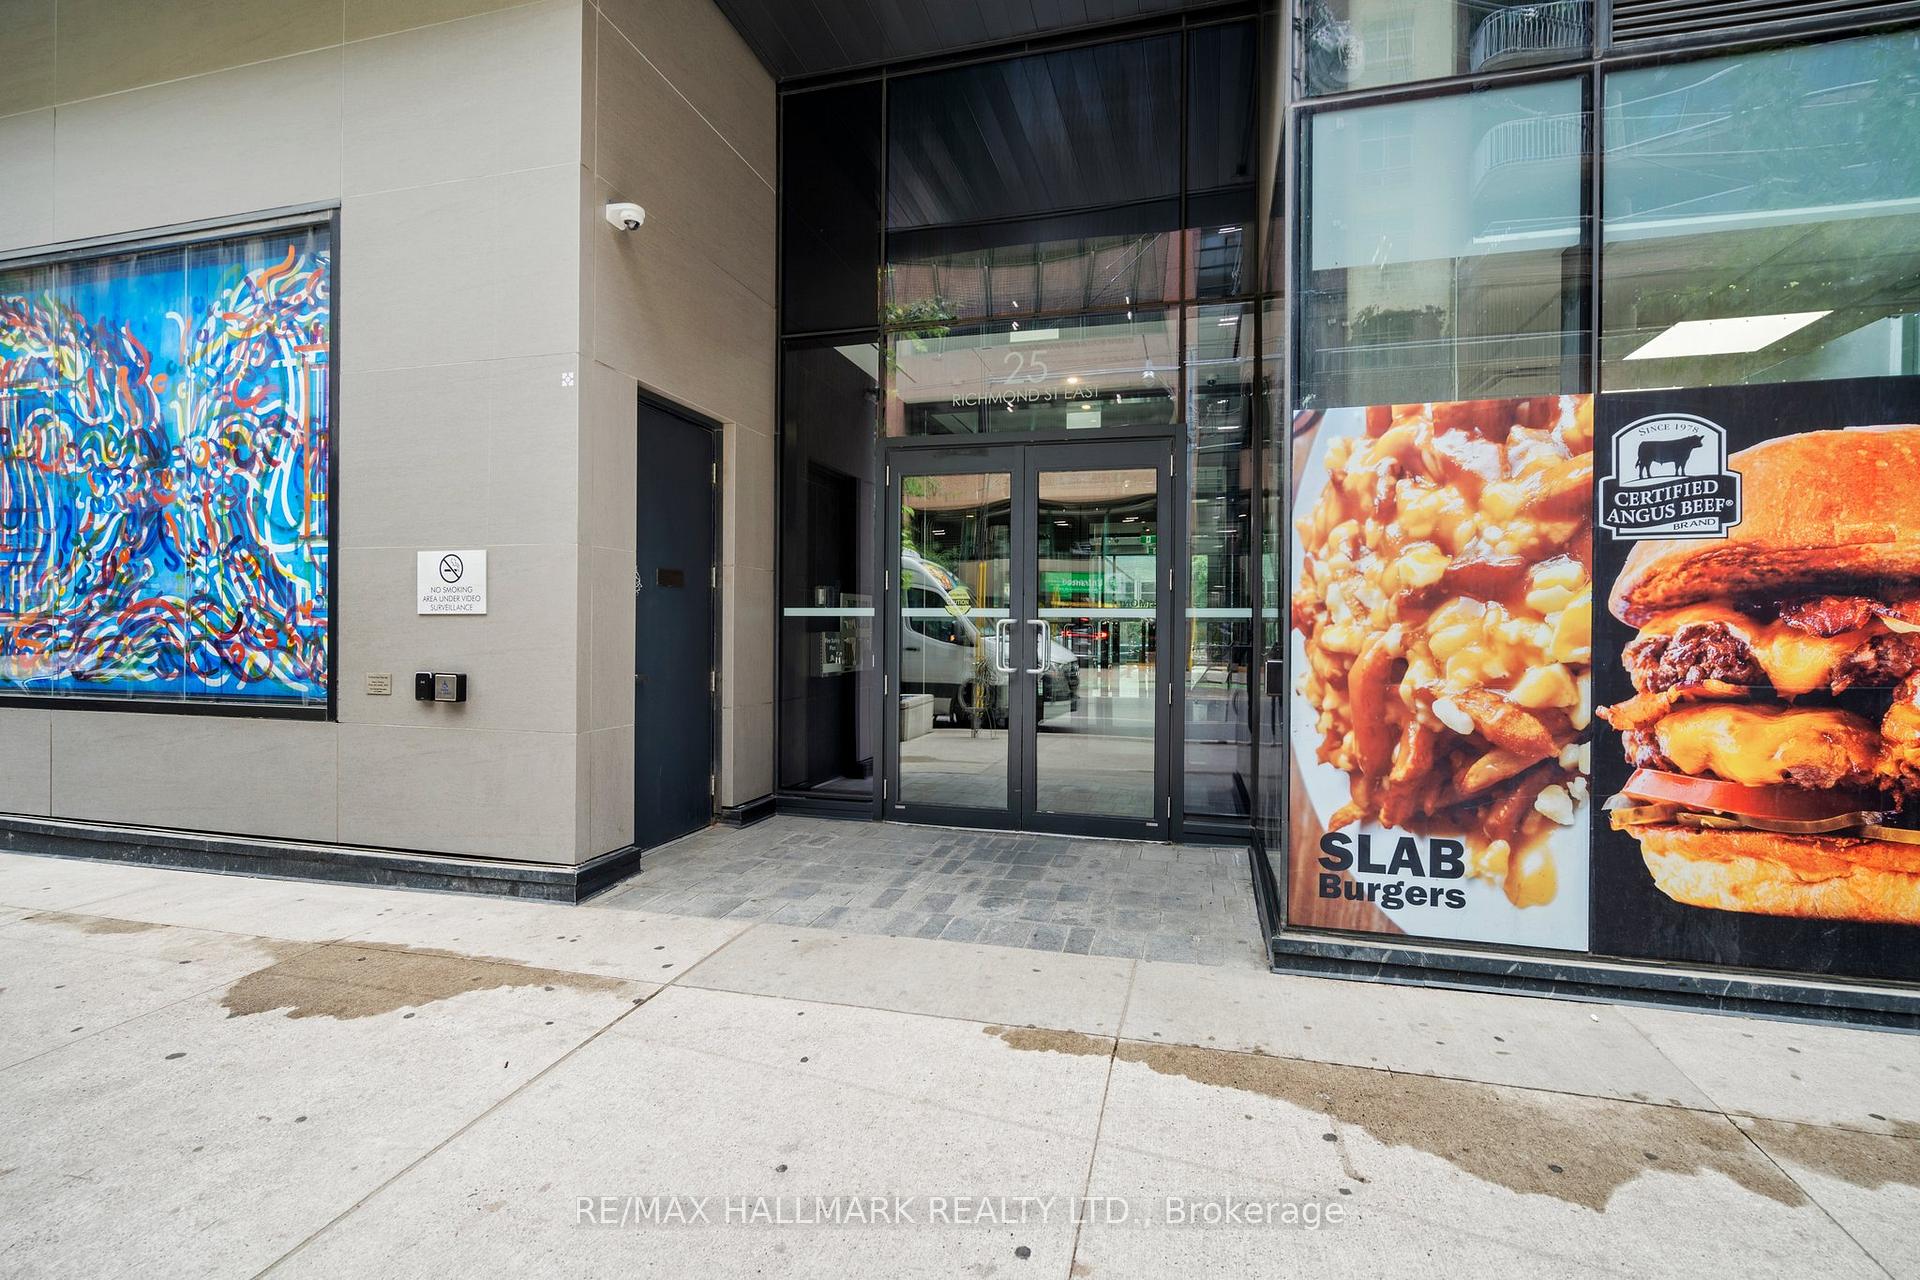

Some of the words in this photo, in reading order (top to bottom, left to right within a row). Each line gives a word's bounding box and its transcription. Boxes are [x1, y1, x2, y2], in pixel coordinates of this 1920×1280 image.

[1004, 350, 1048, 385] 25
[952, 388, 1040, 407] RICHMOND
[1044, 386, 1058, 401] ST
[1064, 384, 1099, 400] EAST
[1638, 423, 1670, 436] SINCE
[1674, 423, 1700, 434] 1978
[1614, 480, 1719, 507] CERTIFIED
[1607, 505, 1676, 524] ANGUS
[1673, 518, 1716, 531] BRAND
[461, 594, 481, 602] VIDEO
[1317, 831, 1466, 880] SLAB
[1319, 873, 1467, 910] Burgers
